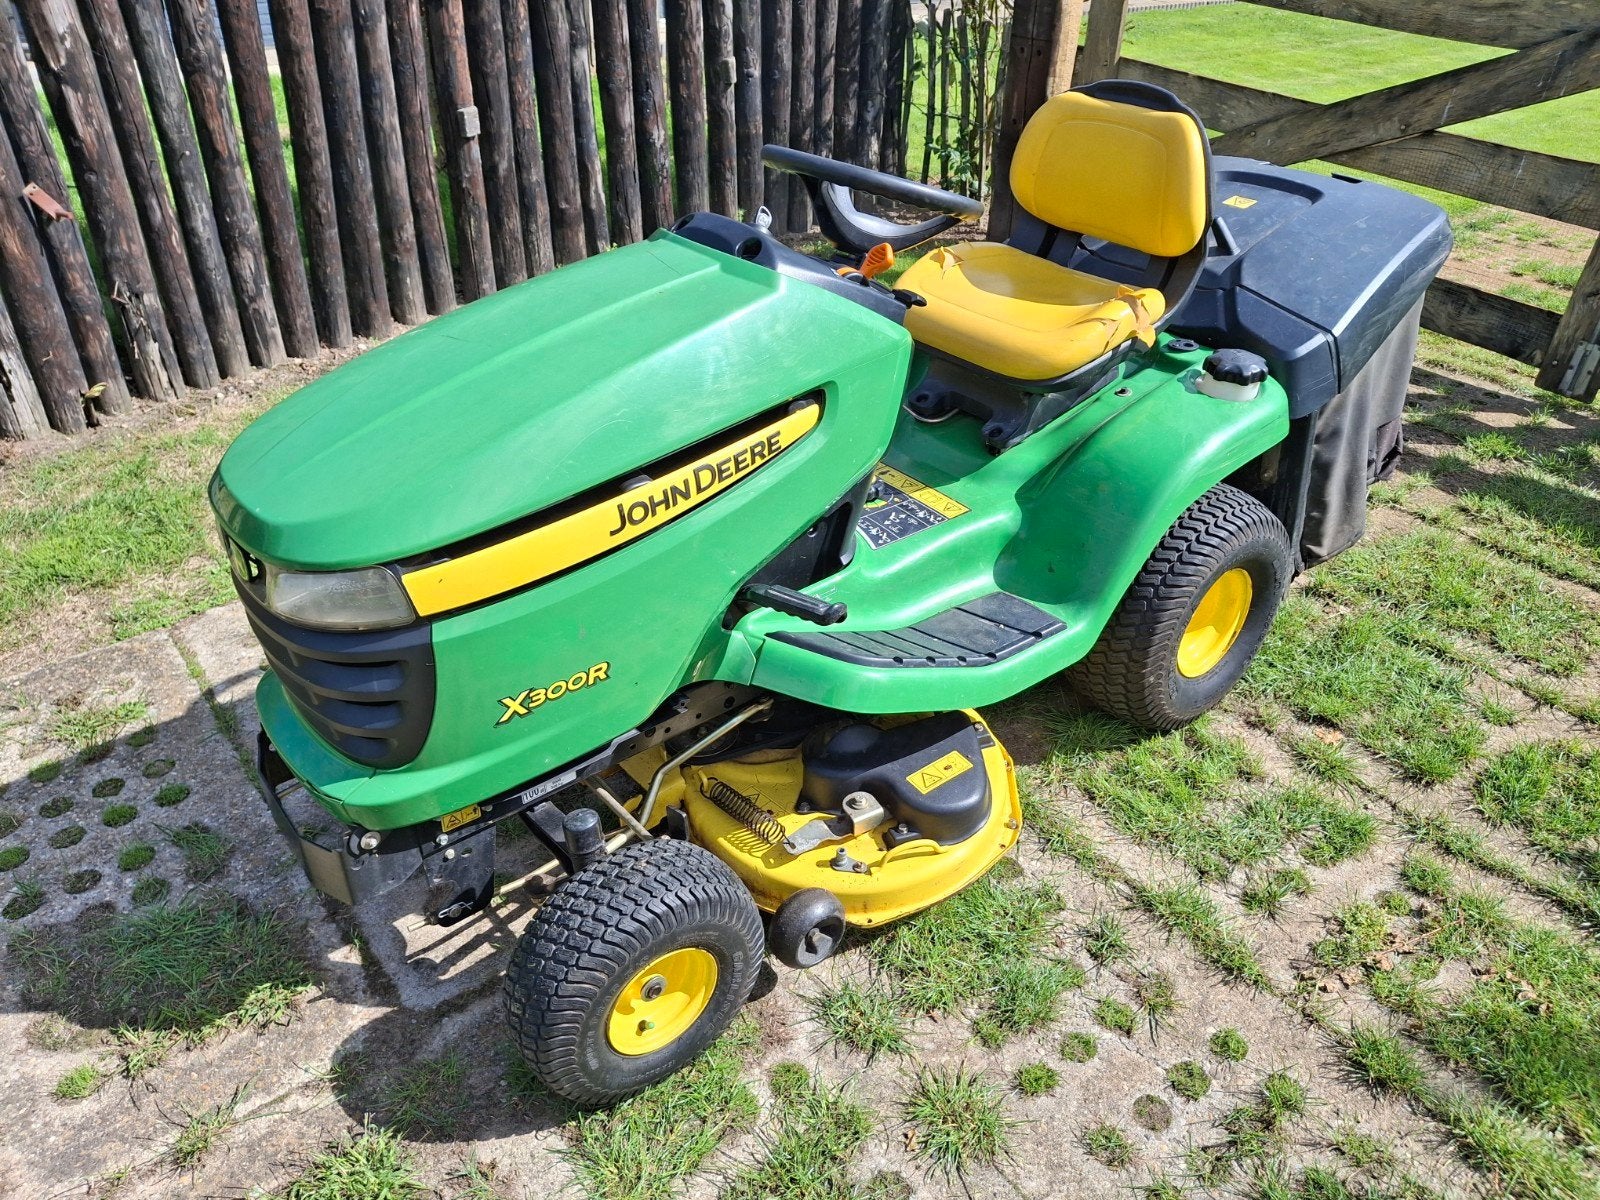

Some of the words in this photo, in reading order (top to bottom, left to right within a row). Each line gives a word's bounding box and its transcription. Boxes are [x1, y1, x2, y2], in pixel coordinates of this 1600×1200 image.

[609, 478, 691, 537] JOHN
[693, 430, 782, 495] DEERE
[494, 661, 611, 727] X300R
